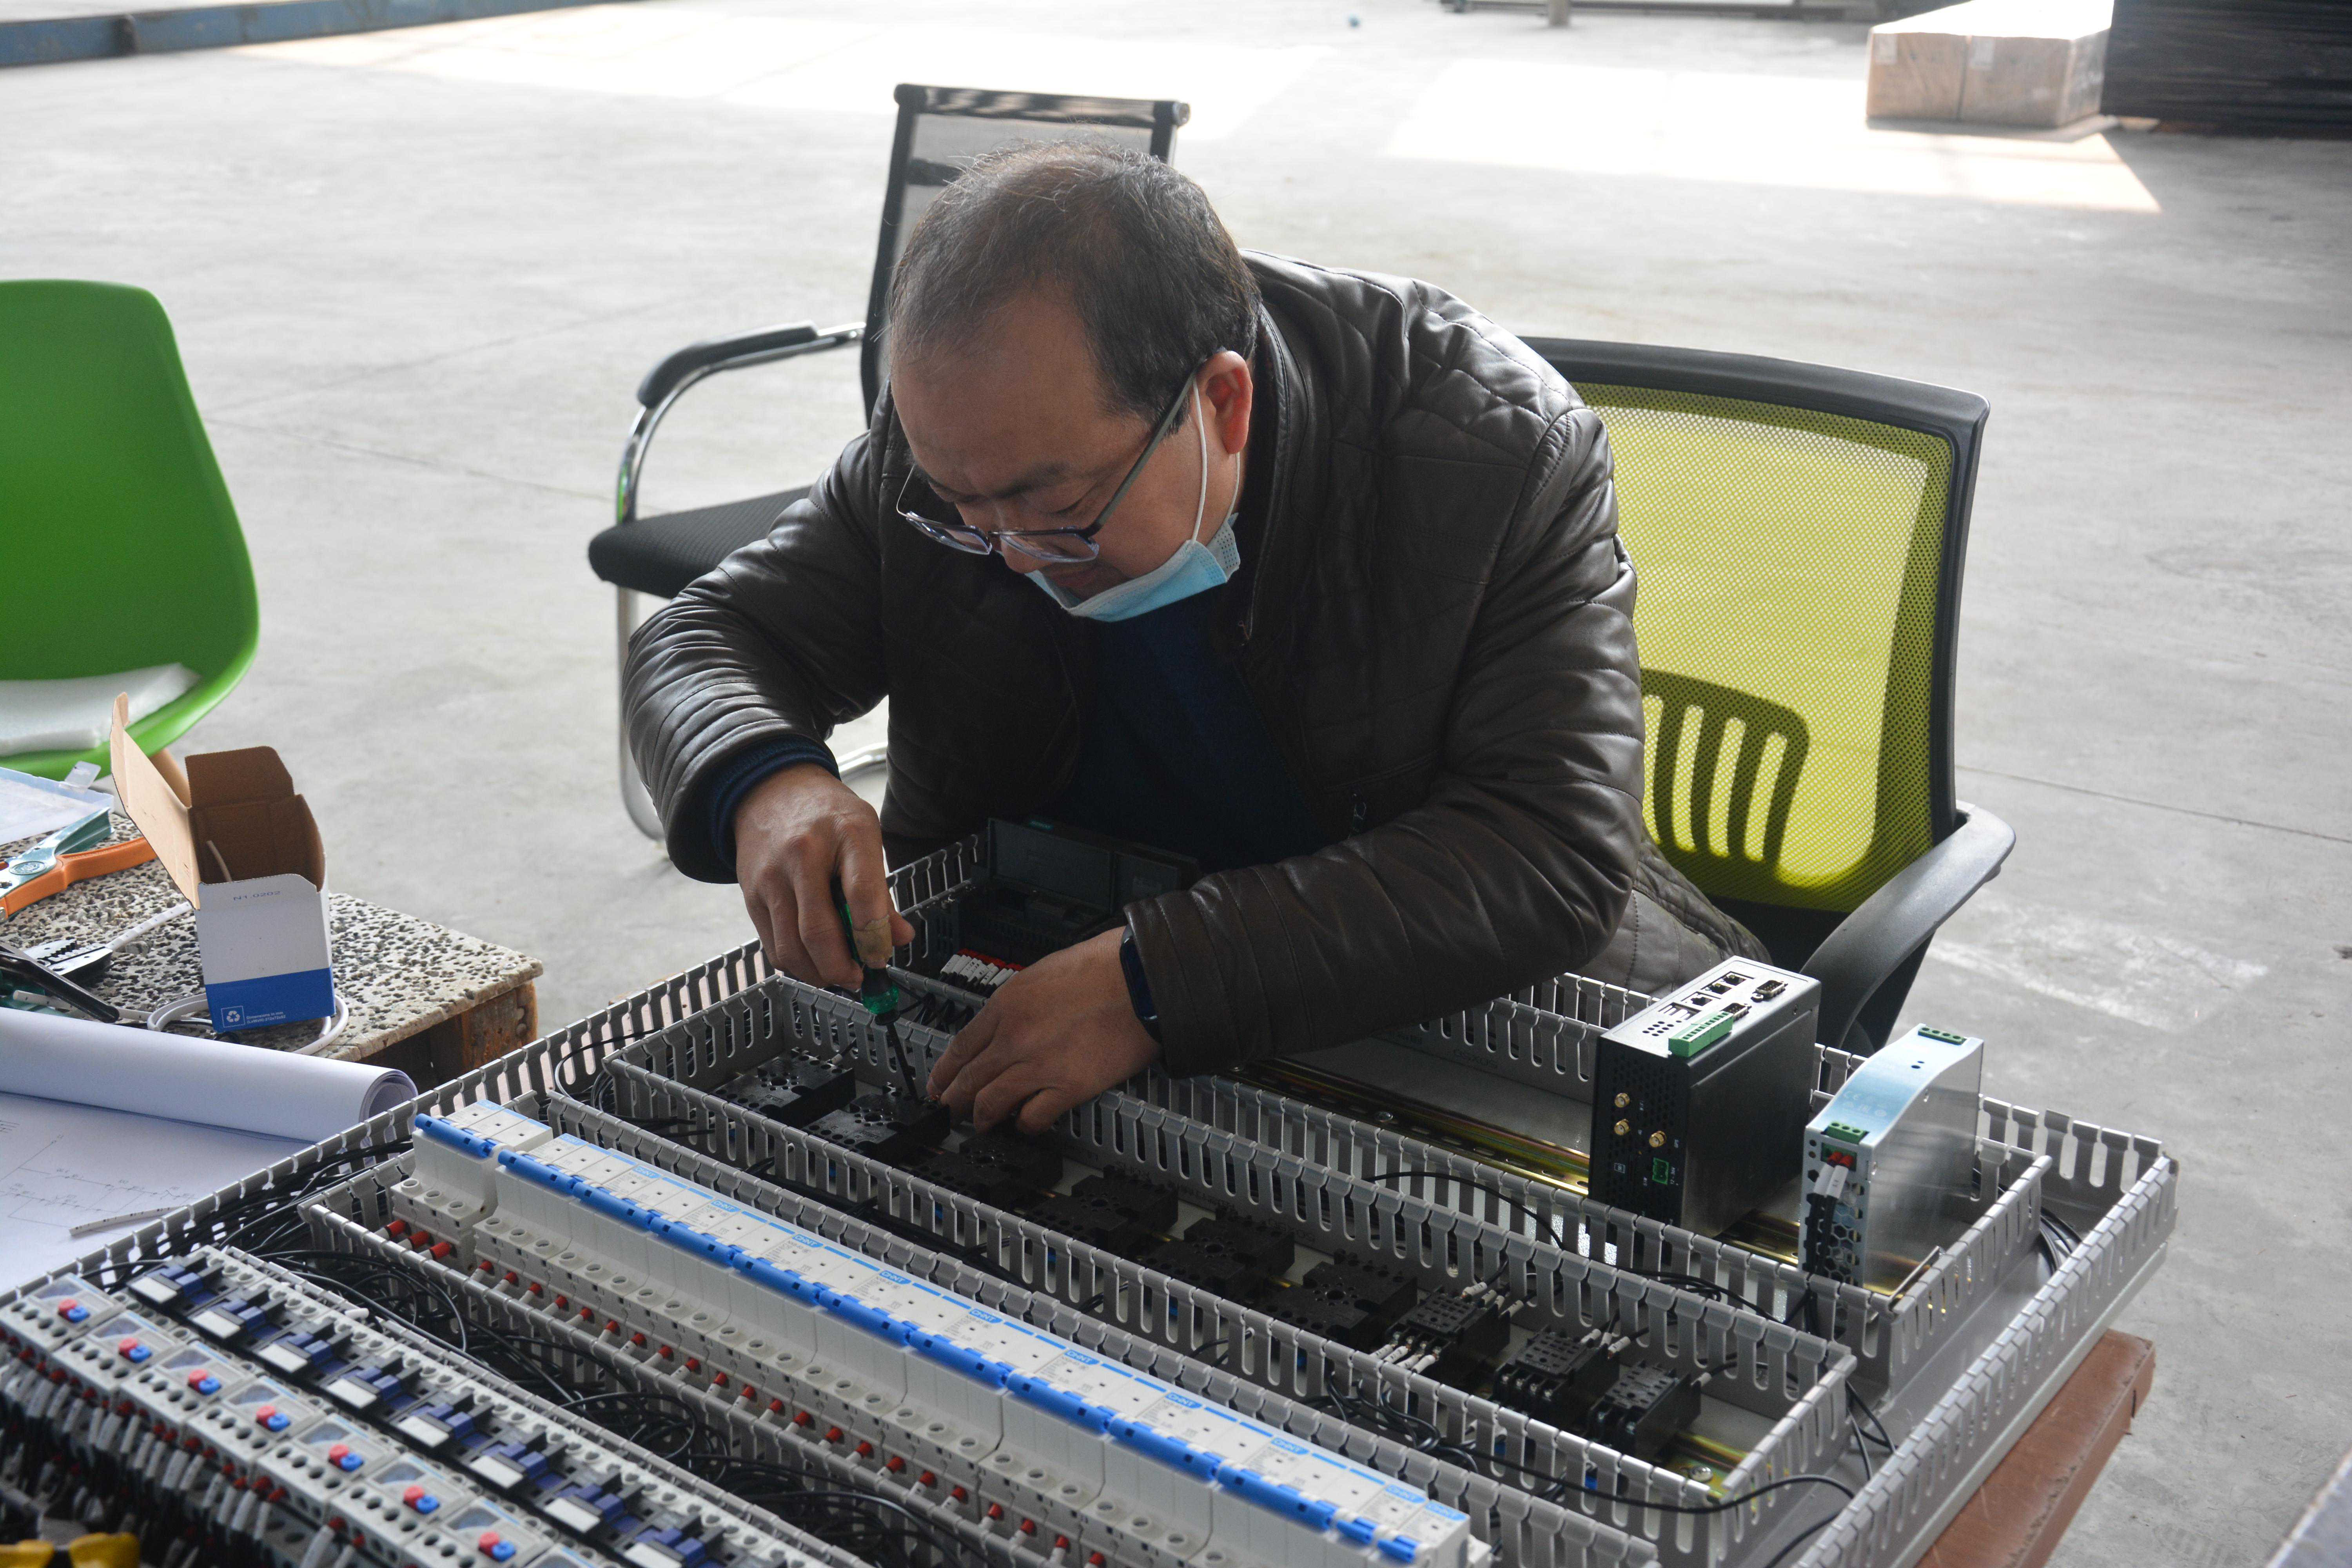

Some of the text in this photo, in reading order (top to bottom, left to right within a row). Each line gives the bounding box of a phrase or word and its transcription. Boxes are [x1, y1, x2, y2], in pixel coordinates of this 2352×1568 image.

[712, 1200, 735, 1212] CHNT
[793, 1234, 818, 1247] CHNT
[880, 1270, 906, 1283] CHNT
[970, 1309, 995, 1321] CHNT
[1066, 1350, 1092, 1363] CHNT
